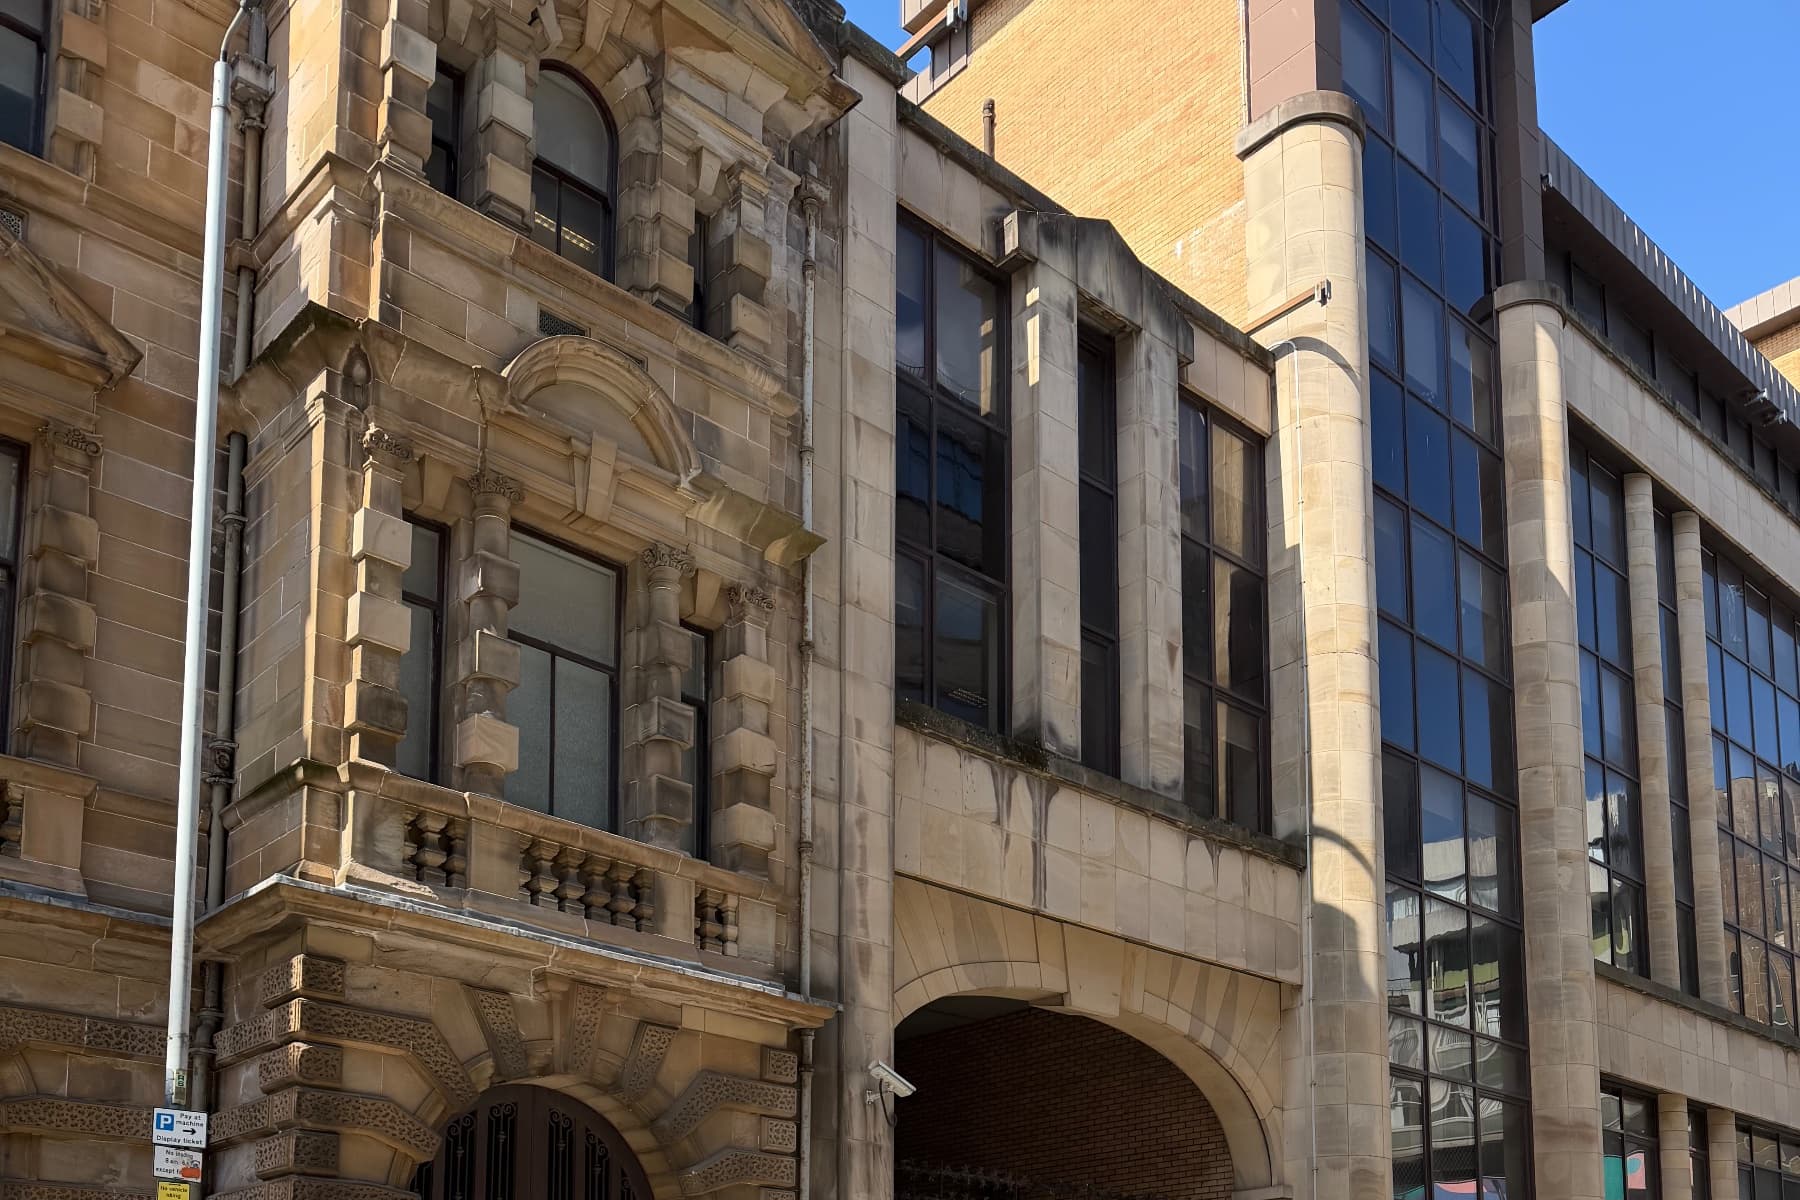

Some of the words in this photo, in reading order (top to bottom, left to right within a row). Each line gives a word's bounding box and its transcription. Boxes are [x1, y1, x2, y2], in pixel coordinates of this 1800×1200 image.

[160, 1114, 172, 1129] P
[175, 1120, 204, 1128] machine
[156, 1135, 181, 1144] Display
